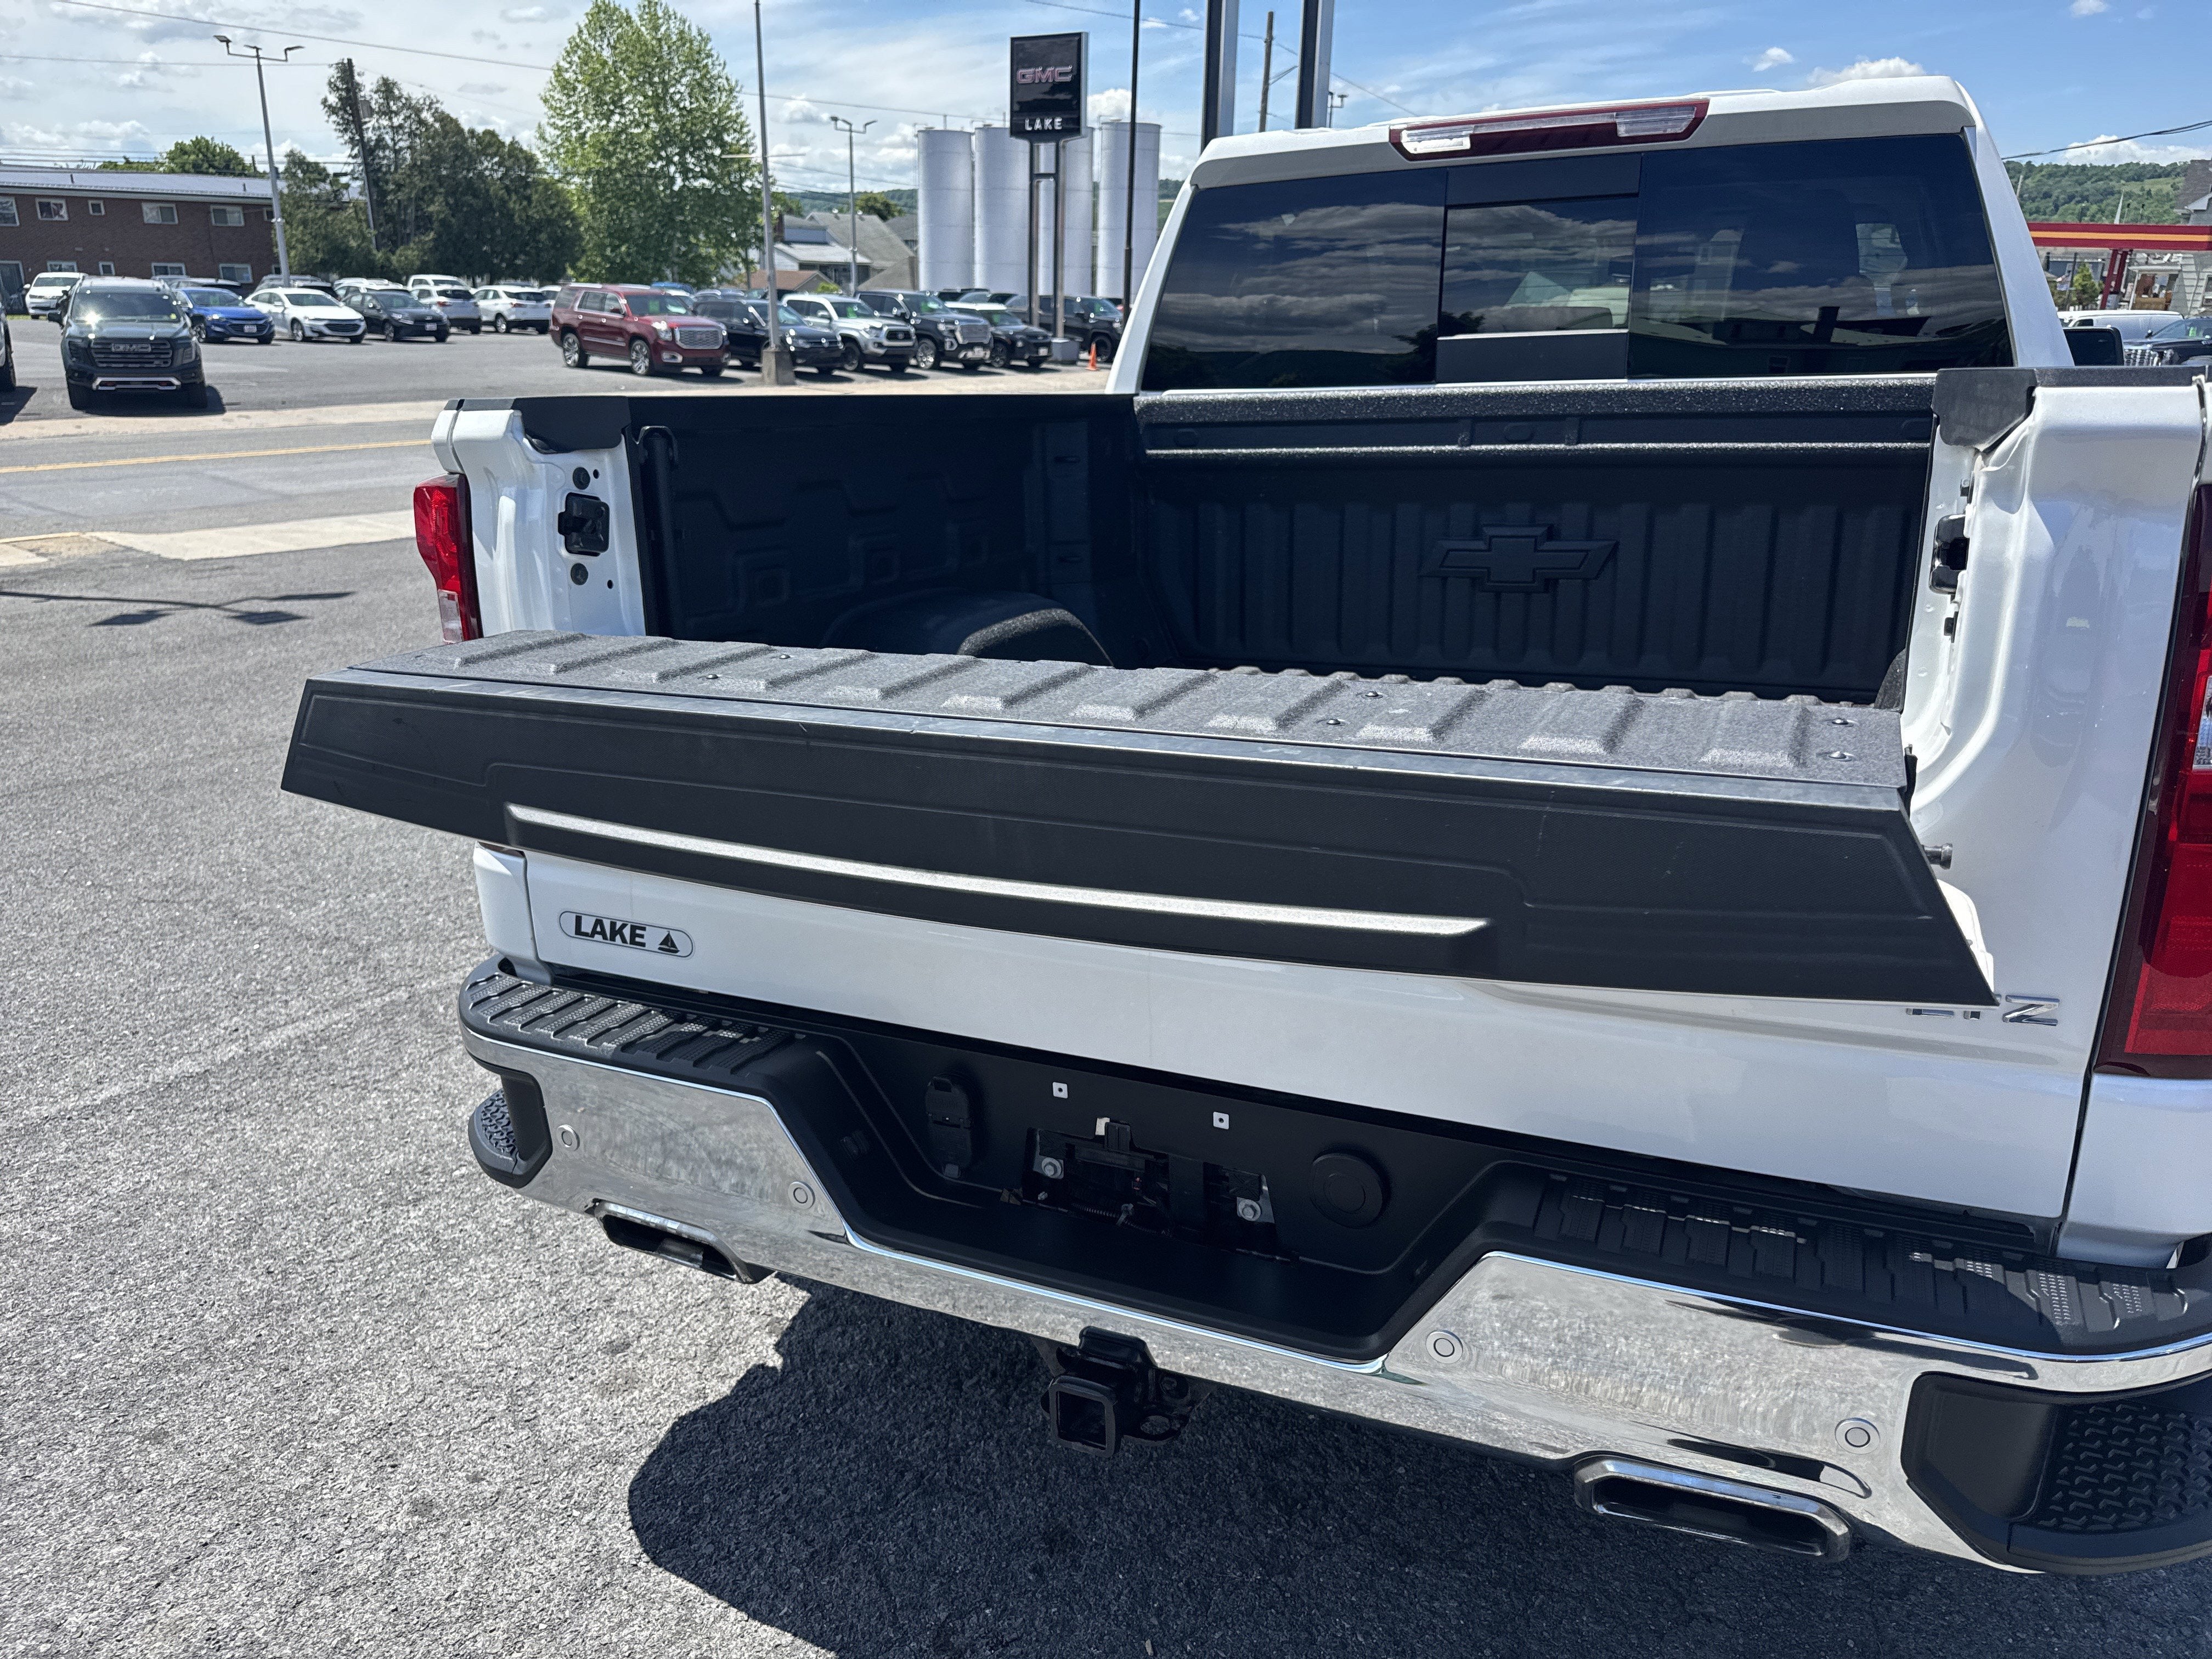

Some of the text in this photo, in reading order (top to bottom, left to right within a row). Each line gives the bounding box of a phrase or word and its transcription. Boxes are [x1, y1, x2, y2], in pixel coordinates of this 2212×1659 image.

[1017, 65, 1073, 84] GMC
[1024, 117, 1063, 131] LAKE
[574, 915, 647, 947] LAKE
